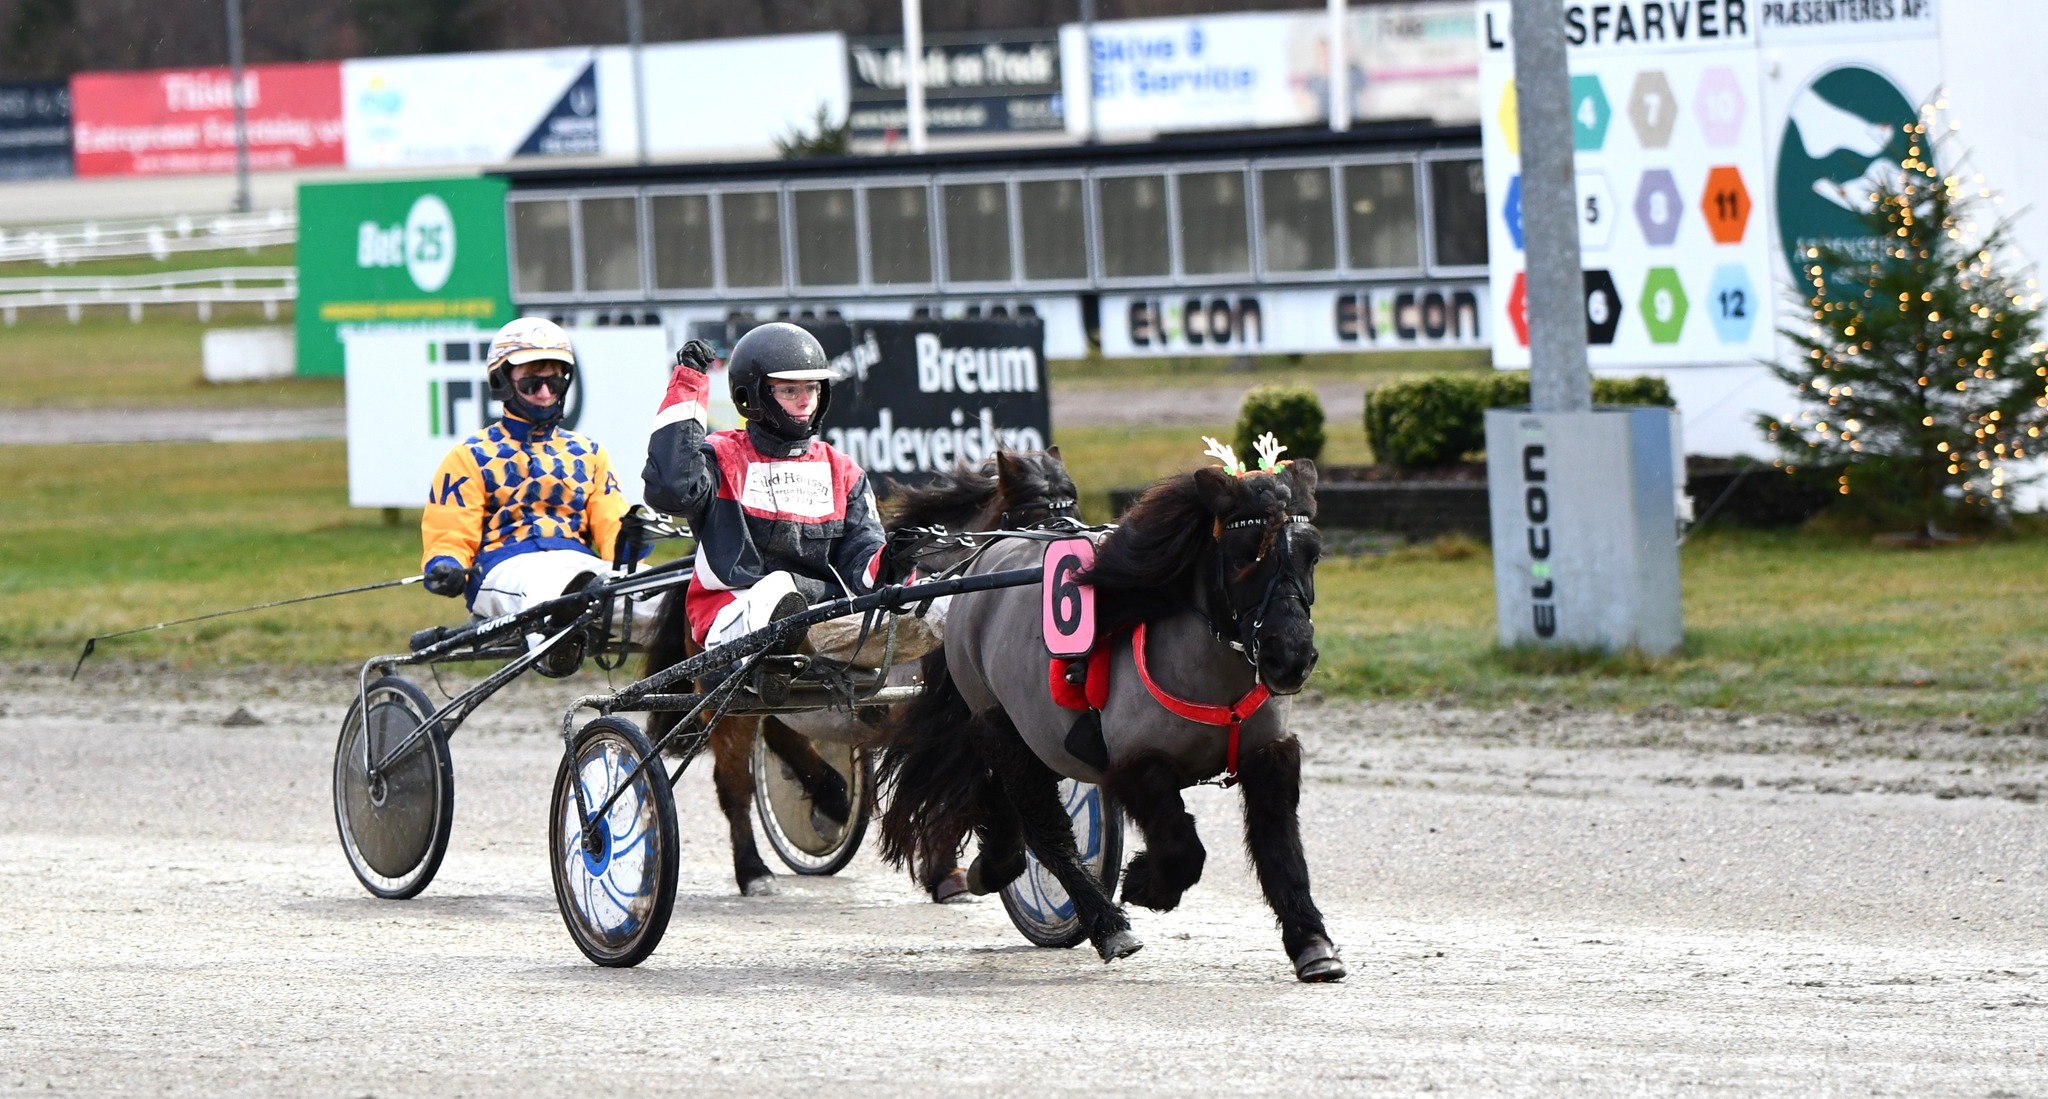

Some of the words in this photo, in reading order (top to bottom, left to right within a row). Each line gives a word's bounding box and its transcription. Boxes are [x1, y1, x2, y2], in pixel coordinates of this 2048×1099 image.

[1487, 0, 1747, 49] LSFARVER
[1577, 96, 1597, 130] 4
[1643, 92, 1663, 128] 7
[1708, 89, 1736, 123] 10
[1585, 196, 1600, 225] 5
[1649, 190, 1670, 226] 8
[1715, 190, 1739, 222] 11
[357, 221, 404, 268] Bet
[414, 224, 444, 262] 25
[1587, 289, 1609, 325] 6
[1653, 287, 1674, 323] 9
[1718, 290, 1746, 319] 12
[915, 332, 1040, 394] Breum
[1052, 554, 1083, 636] 6
